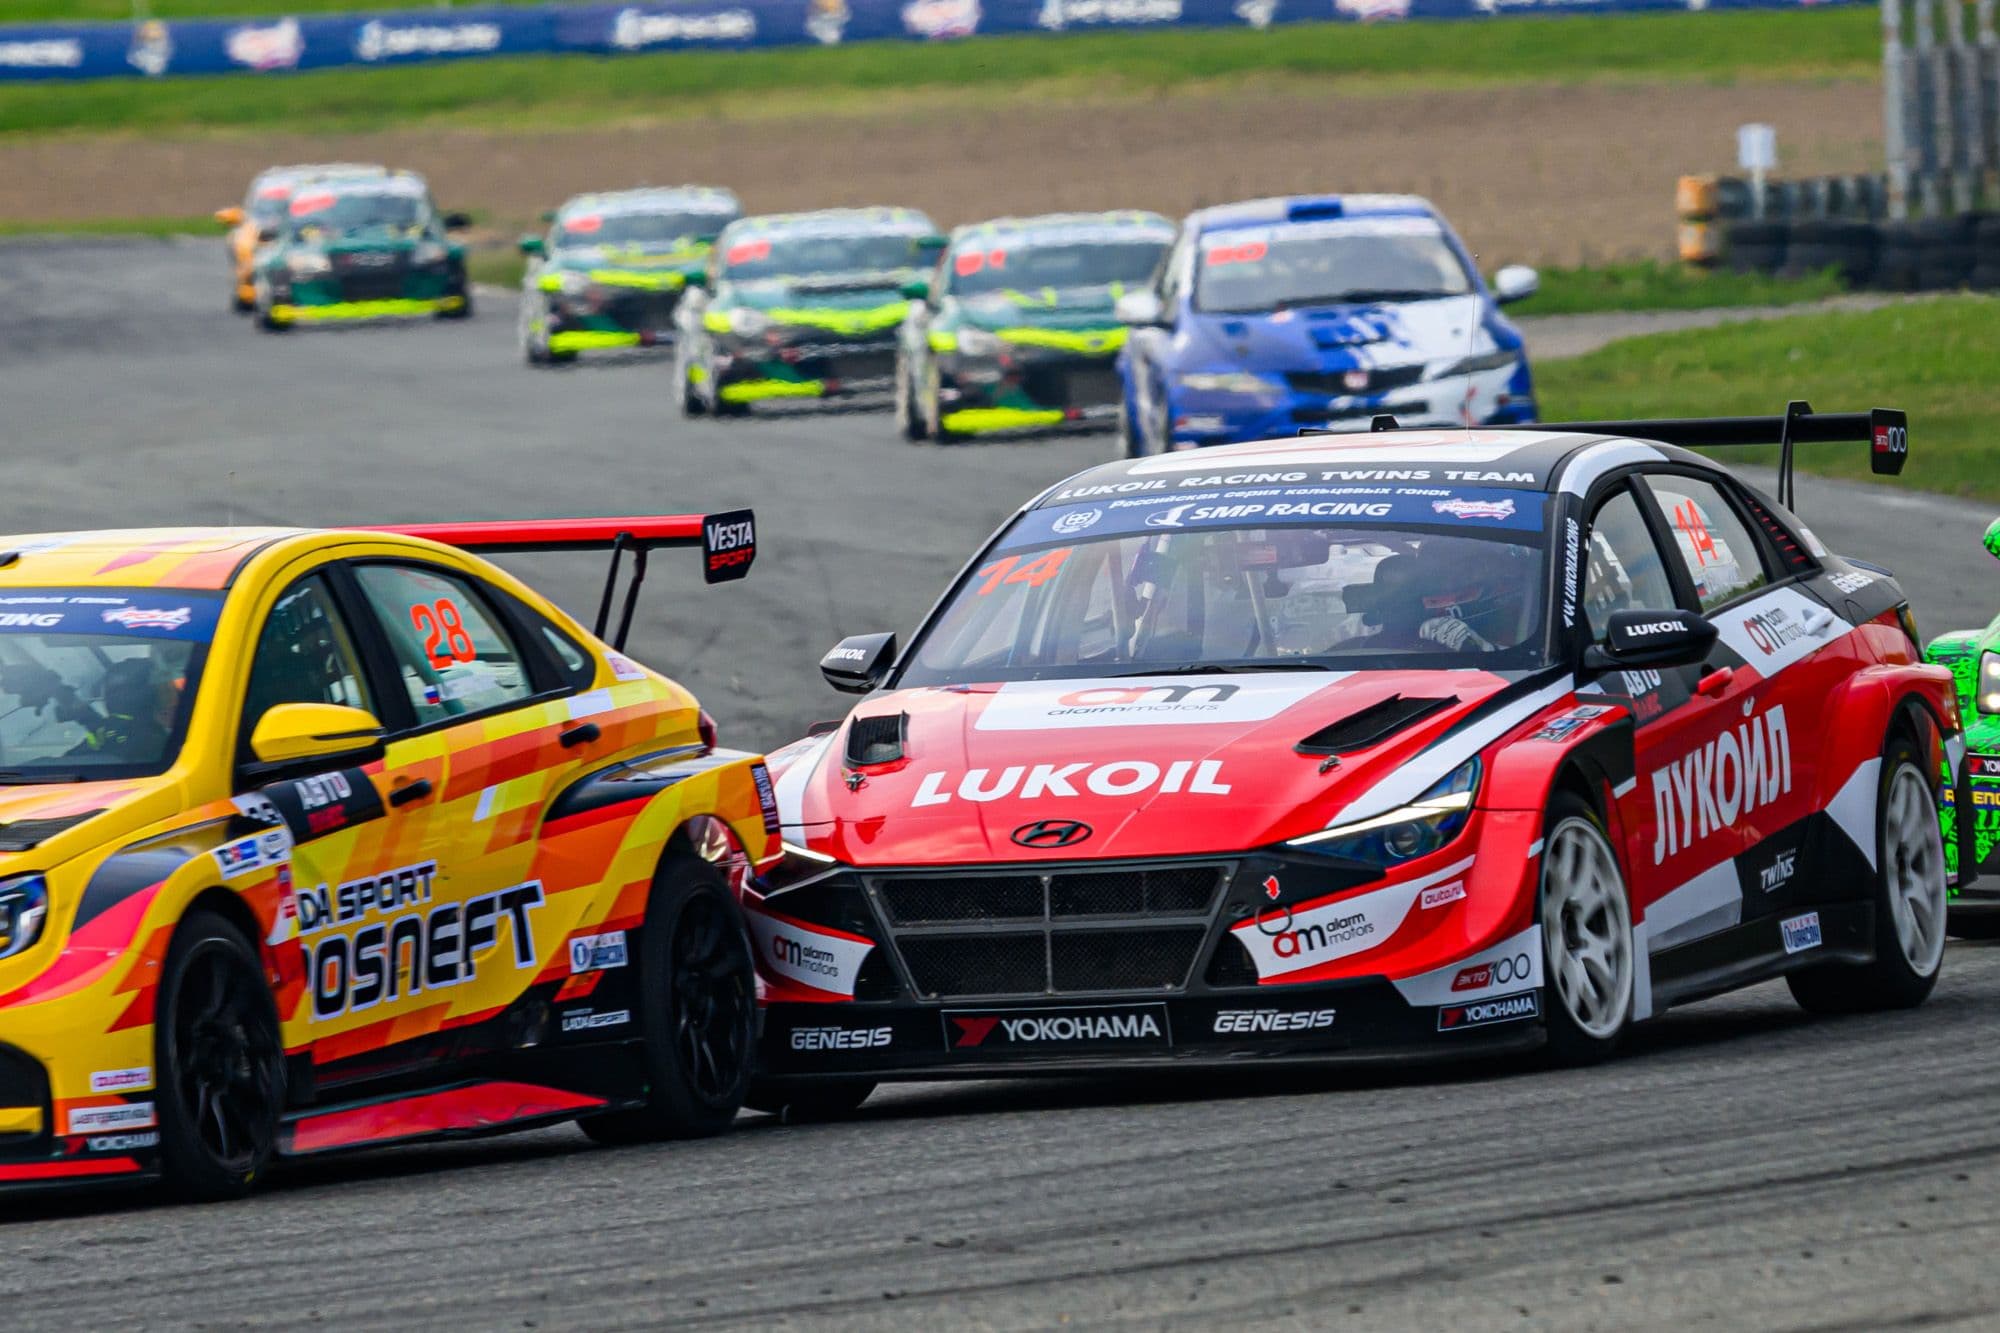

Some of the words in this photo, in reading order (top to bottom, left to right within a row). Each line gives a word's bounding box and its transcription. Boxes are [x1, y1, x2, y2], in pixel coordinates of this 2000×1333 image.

[1056, 479, 1167, 500] LUKOIL
[1178, 471, 1308, 488] RACING
[1321, 470, 1431, 482] TWINS
[1444, 470, 1536, 483] TEAM
[1108, 492, 1220, 510] Российская
[1223, 489, 1281, 499] серия
[1284, 486, 1391, 497] кольцевых
[1395, 487, 1452, 497] гонок
[1189, 504, 1265, 521] SMP
[1265, 502, 1393, 517] RACING
[706, 521, 754, 552] VESTA
[709, 547, 753, 571] SPORT
[976, 547, 1073, 597] 14
[409, 597, 478, 672] 28
[1625, 620, 1689, 637] LUKOIL
[1057, 684, 1241, 708] am
[910, 760, 1232, 808] LUKOIL
[1651, 695, 1792, 866] ЛУКОЙЛ
[336, 858, 438, 925] SPORT
[1423, 884, 1462, 905] auto.ru
[1272, 923, 1328, 959] am
[1326, 912, 1366, 933] alarm
[1328, 921, 1375, 945] motors
[302, 878, 546, 1022] OSNEFT
[802, 945, 835, 963] alarm
[802, 959, 840, 978] motors
[1489, 952, 1531, 986] 100
[1213, 1009, 1337, 1033] GENESIS
[1465, 996, 1535, 1022] YOKOHAMA
[791, 1026, 893, 1050] GENESIS
[1000, 1013, 1161, 1042] YOKOHAMA
